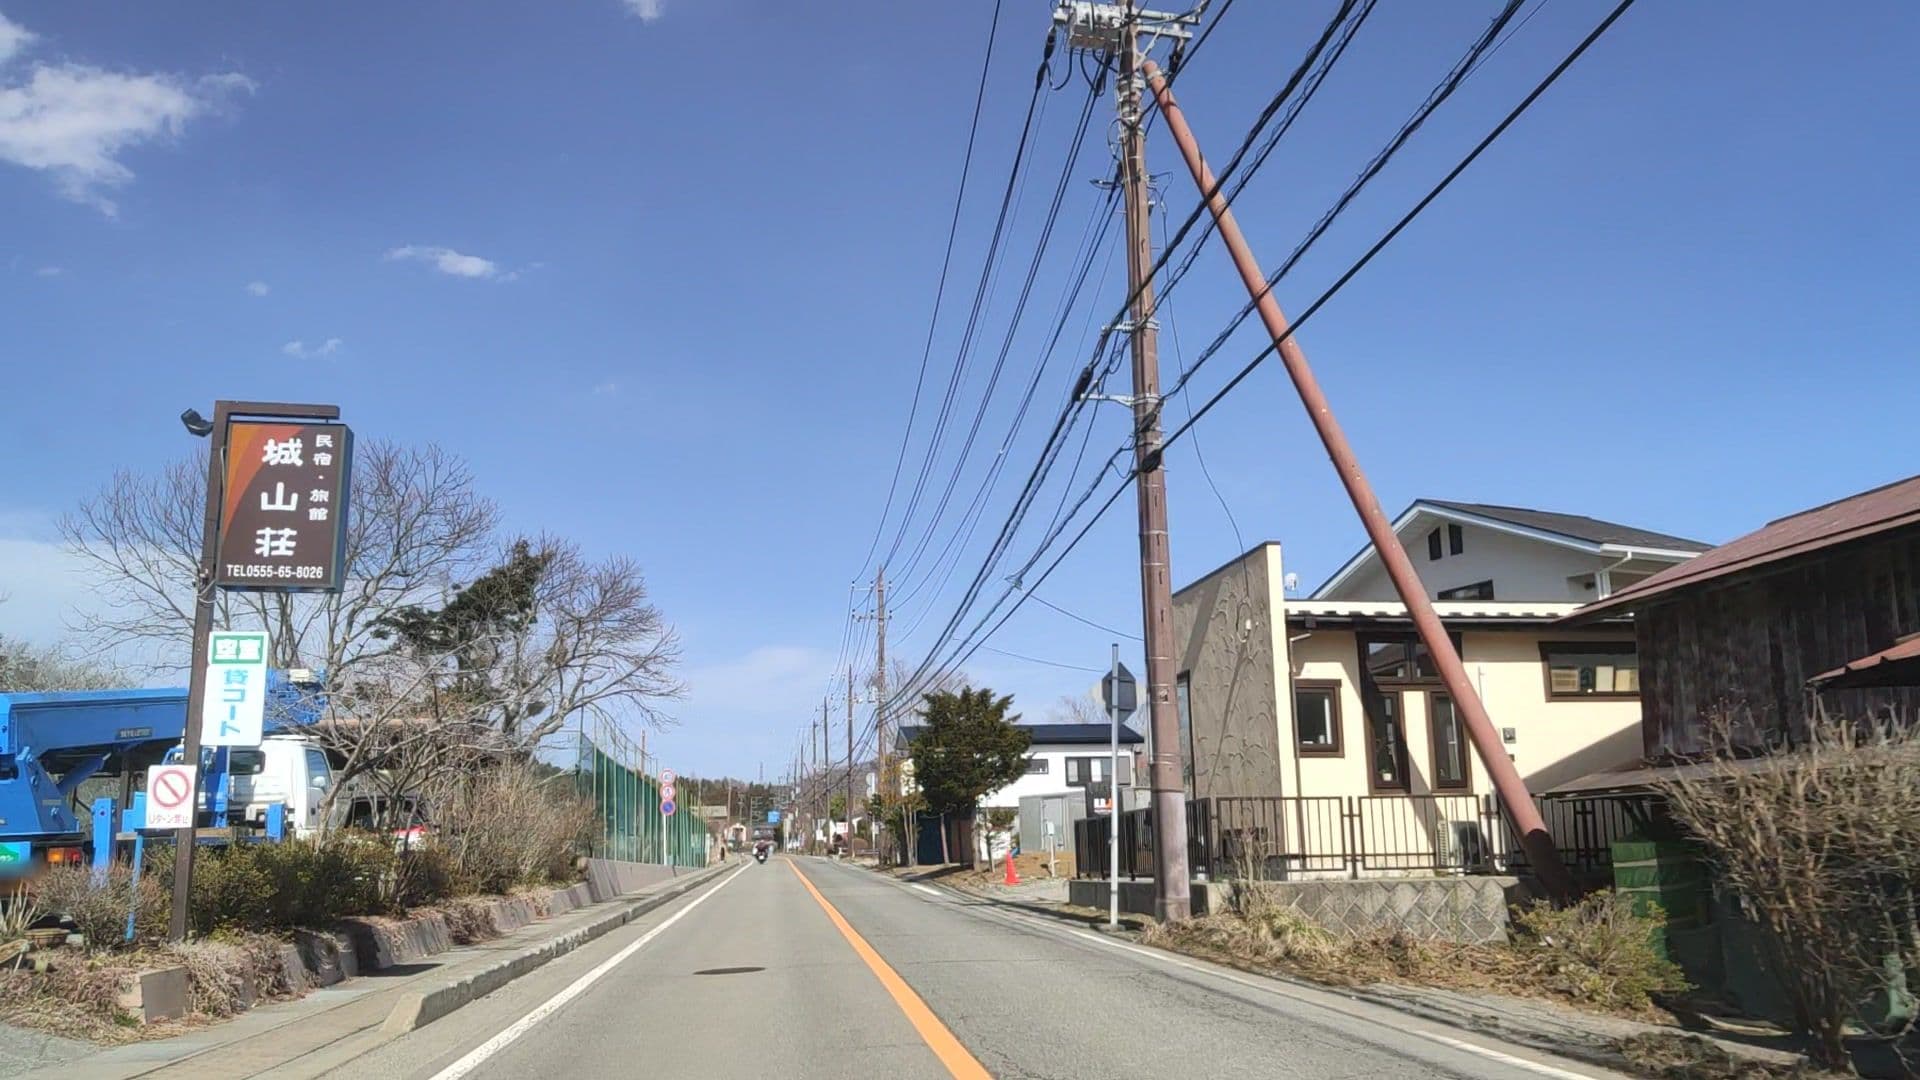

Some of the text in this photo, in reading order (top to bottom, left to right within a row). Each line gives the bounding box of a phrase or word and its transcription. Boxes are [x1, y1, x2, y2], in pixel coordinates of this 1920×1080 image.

[254, 437, 304, 558] 城山荘
[226, 563, 324, 579] TEL0555-65-8026
